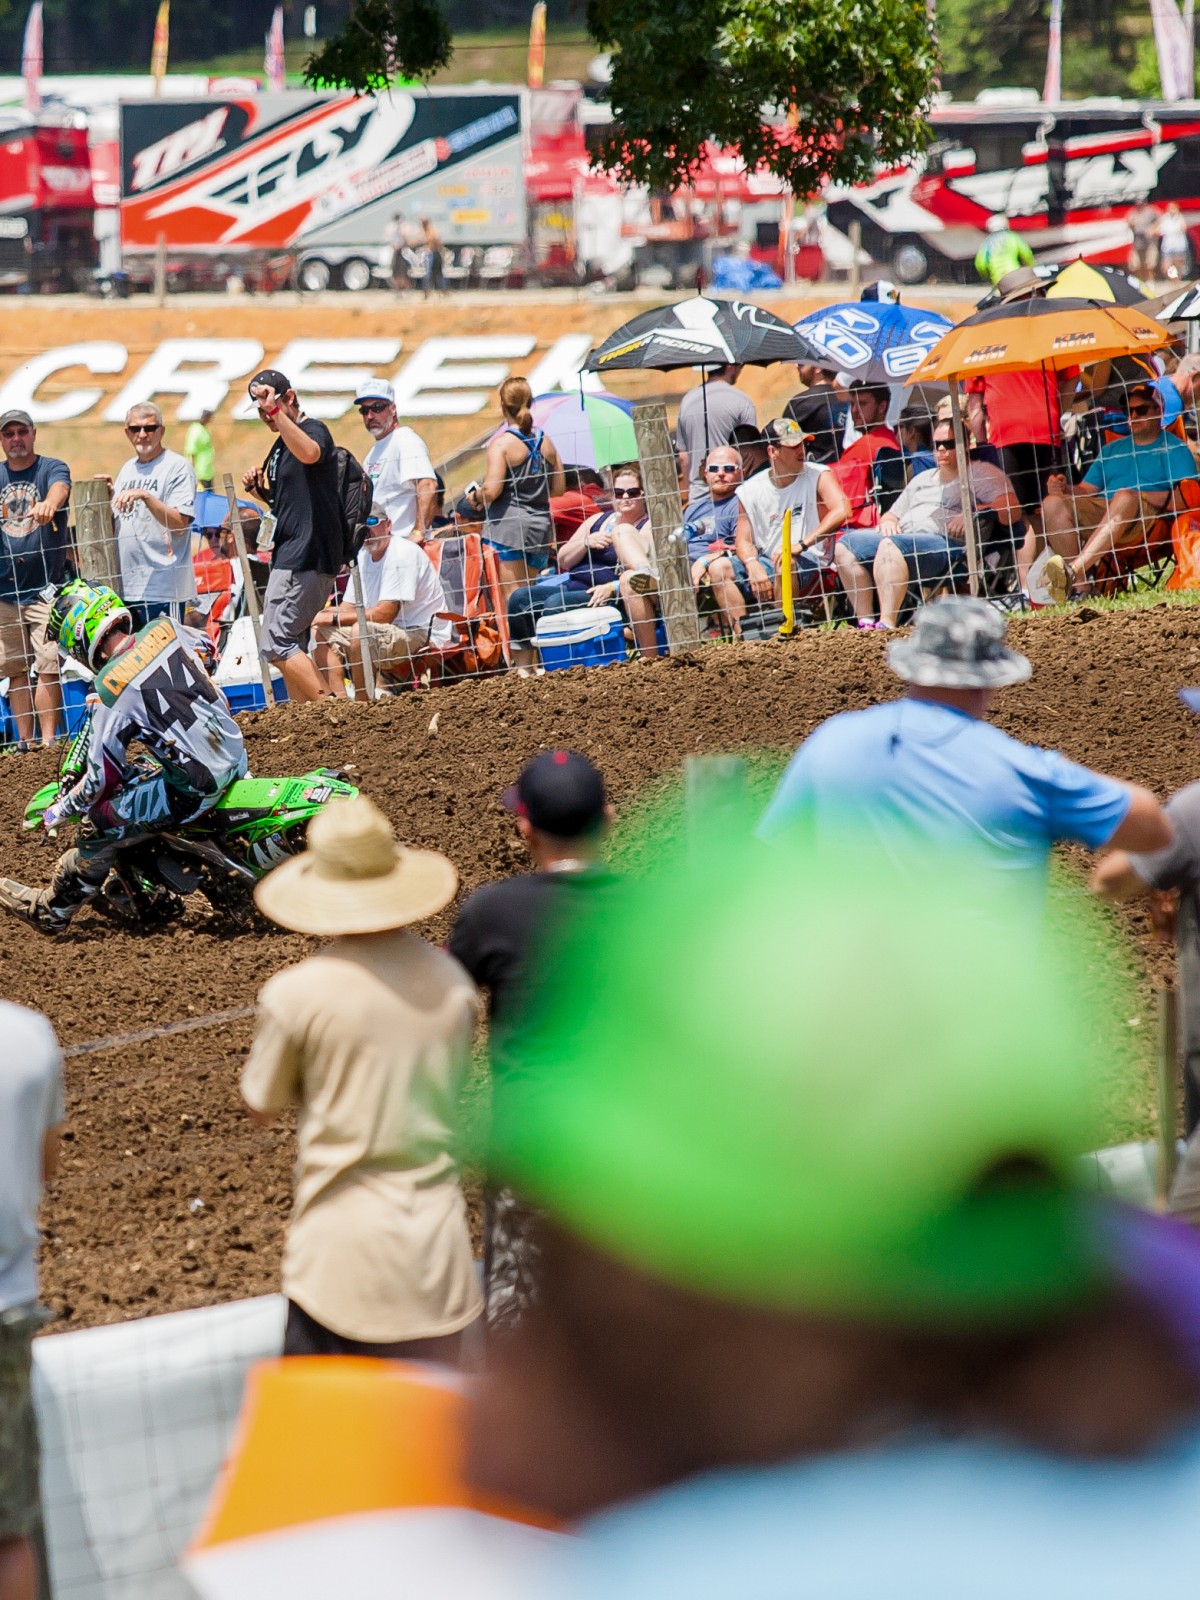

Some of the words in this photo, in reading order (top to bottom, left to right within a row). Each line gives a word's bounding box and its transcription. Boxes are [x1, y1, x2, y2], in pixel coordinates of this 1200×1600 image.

[1054, 330, 1096, 343] KTM
[970, 343, 1009, 357] KTM
[120, 479, 158, 492] AMAHA
